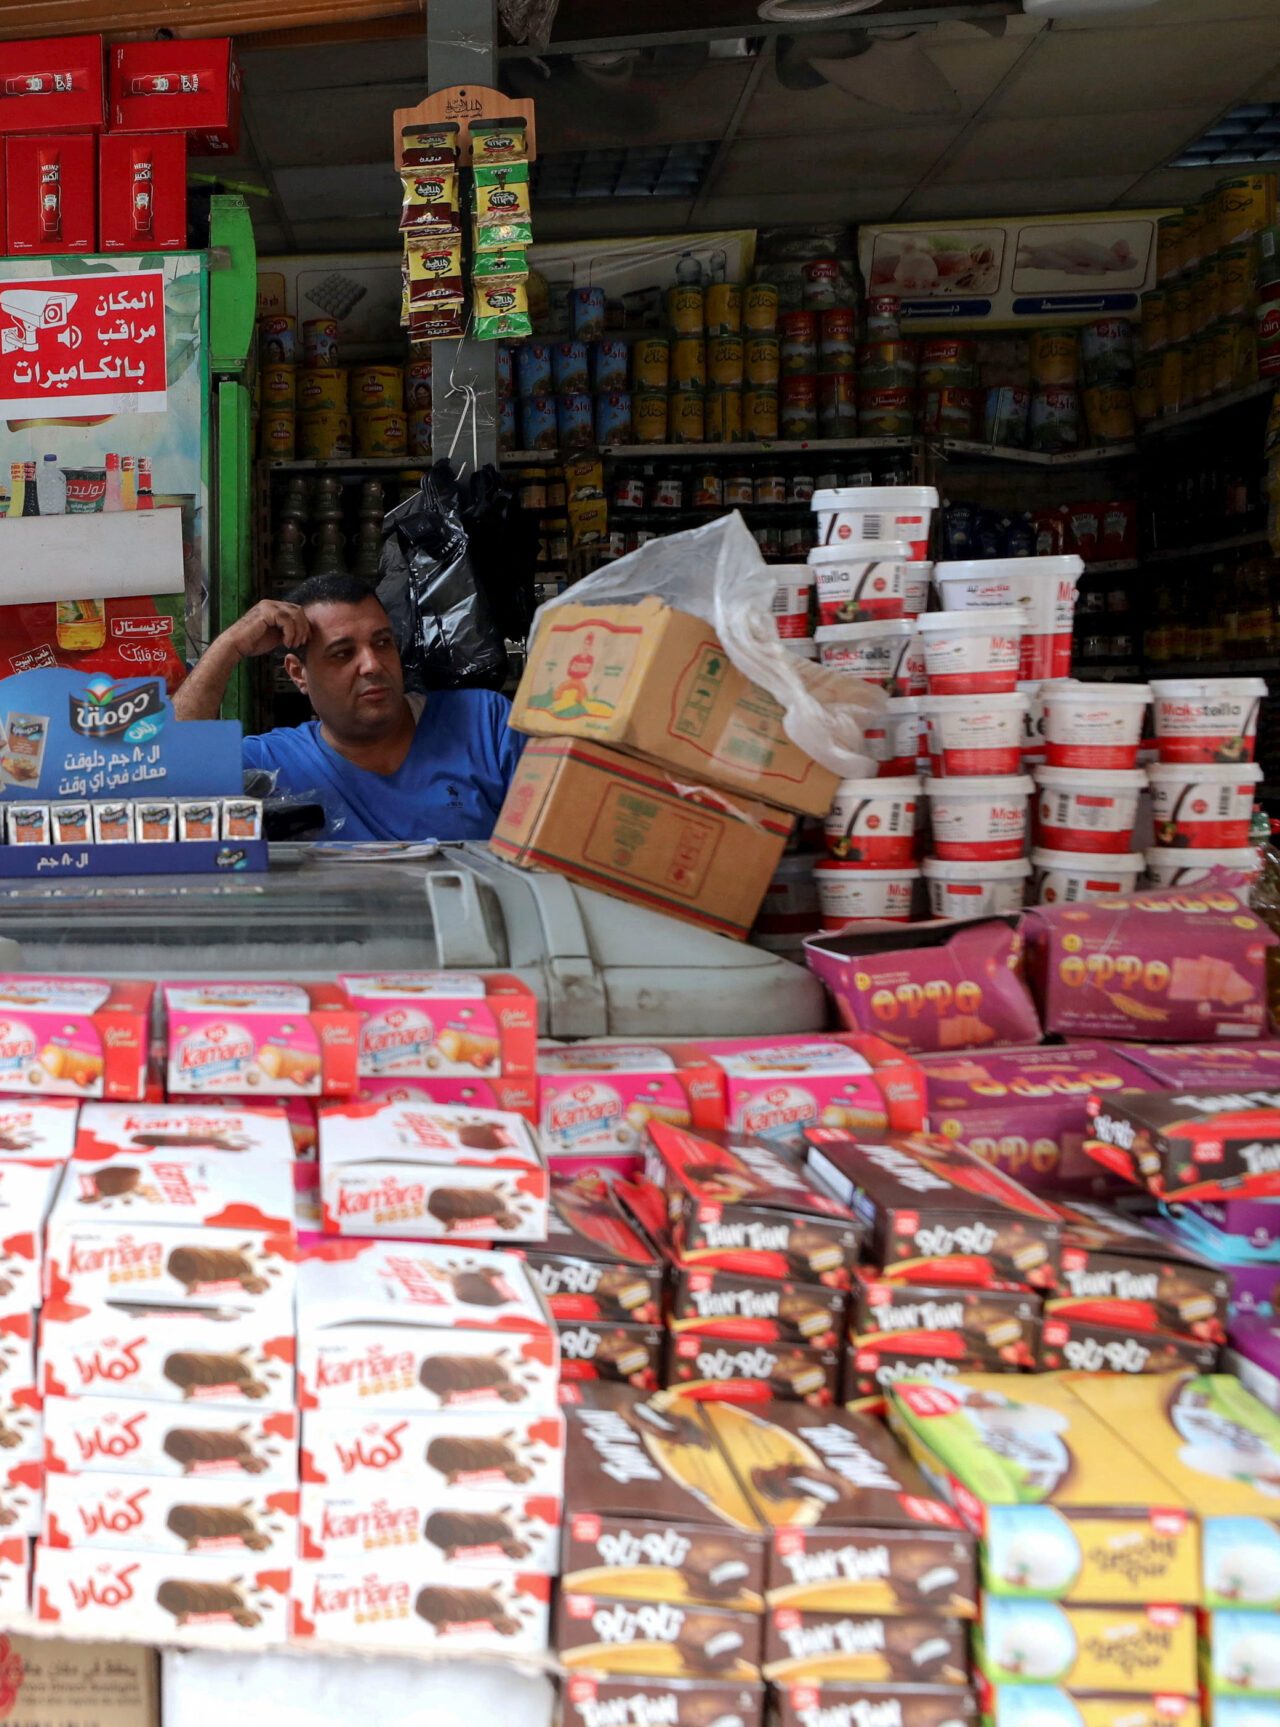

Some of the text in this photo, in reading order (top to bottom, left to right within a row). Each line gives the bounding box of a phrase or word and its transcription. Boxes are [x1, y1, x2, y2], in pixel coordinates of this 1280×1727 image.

[41, 164, 60, 172] HEINZ
[133, 163, 152, 171] HEINZ
[95, 290, 154, 318] المكان
[97, 320, 156, 346] مراقب
[13, 356, 145, 389] بالكاميرات
[115, 619, 170, 636] كريستال
[76, 692, 150, 728] دومتي
[1162, 702, 1241, 718] Makstella
[64, 749, 106, 773] دلوقت
[108, 753, 130, 772] جم
[131, 764, 167, 782] معاك
[58, 776, 87, 797] وقت
[337, 1183, 425, 1217] kamara
[69, 1240, 163, 1275] kamara
[317, 1351, 415, 1388] kamara
[322, 1507, 419, 1541] kamara
[313, 1579, 410, 1614] kamara
